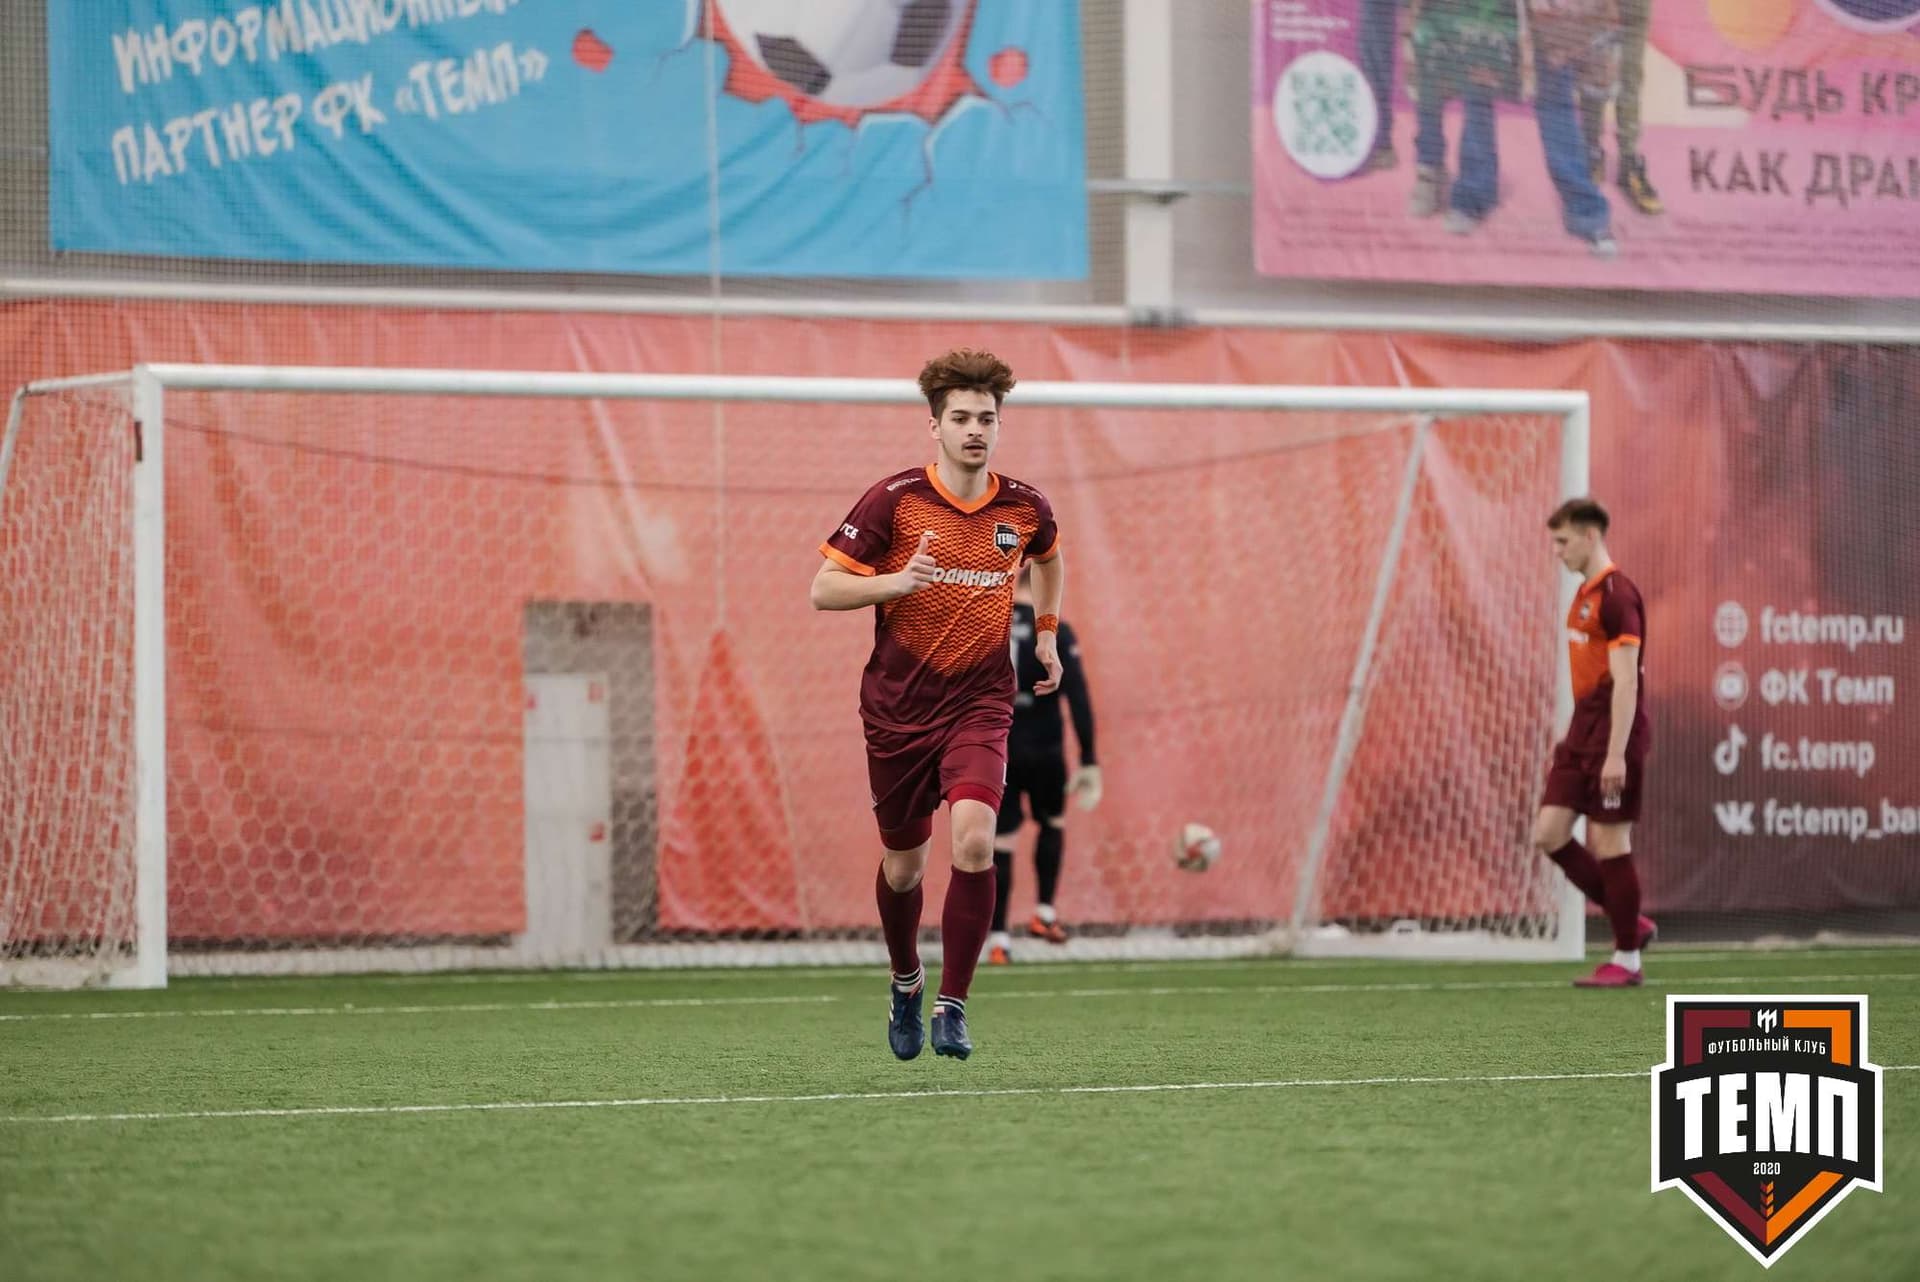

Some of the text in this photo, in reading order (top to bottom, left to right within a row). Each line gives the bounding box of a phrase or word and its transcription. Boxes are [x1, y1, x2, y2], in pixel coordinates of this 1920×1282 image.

[111, 41, 549, 185] ПАРТНЕР ФК «ТЕМП»
[1684, 64, 1844, 122] БУДЬ
[1689, 147, 1791, 196] КАК
[1760, 605, 1904, 653] fctemp.ru
[1760, 668, 1895, 706] ФК Темп
[1760, 732, 1876, 778] fc.temp
[1762, 798, 1920, 843] fctemp_ba
